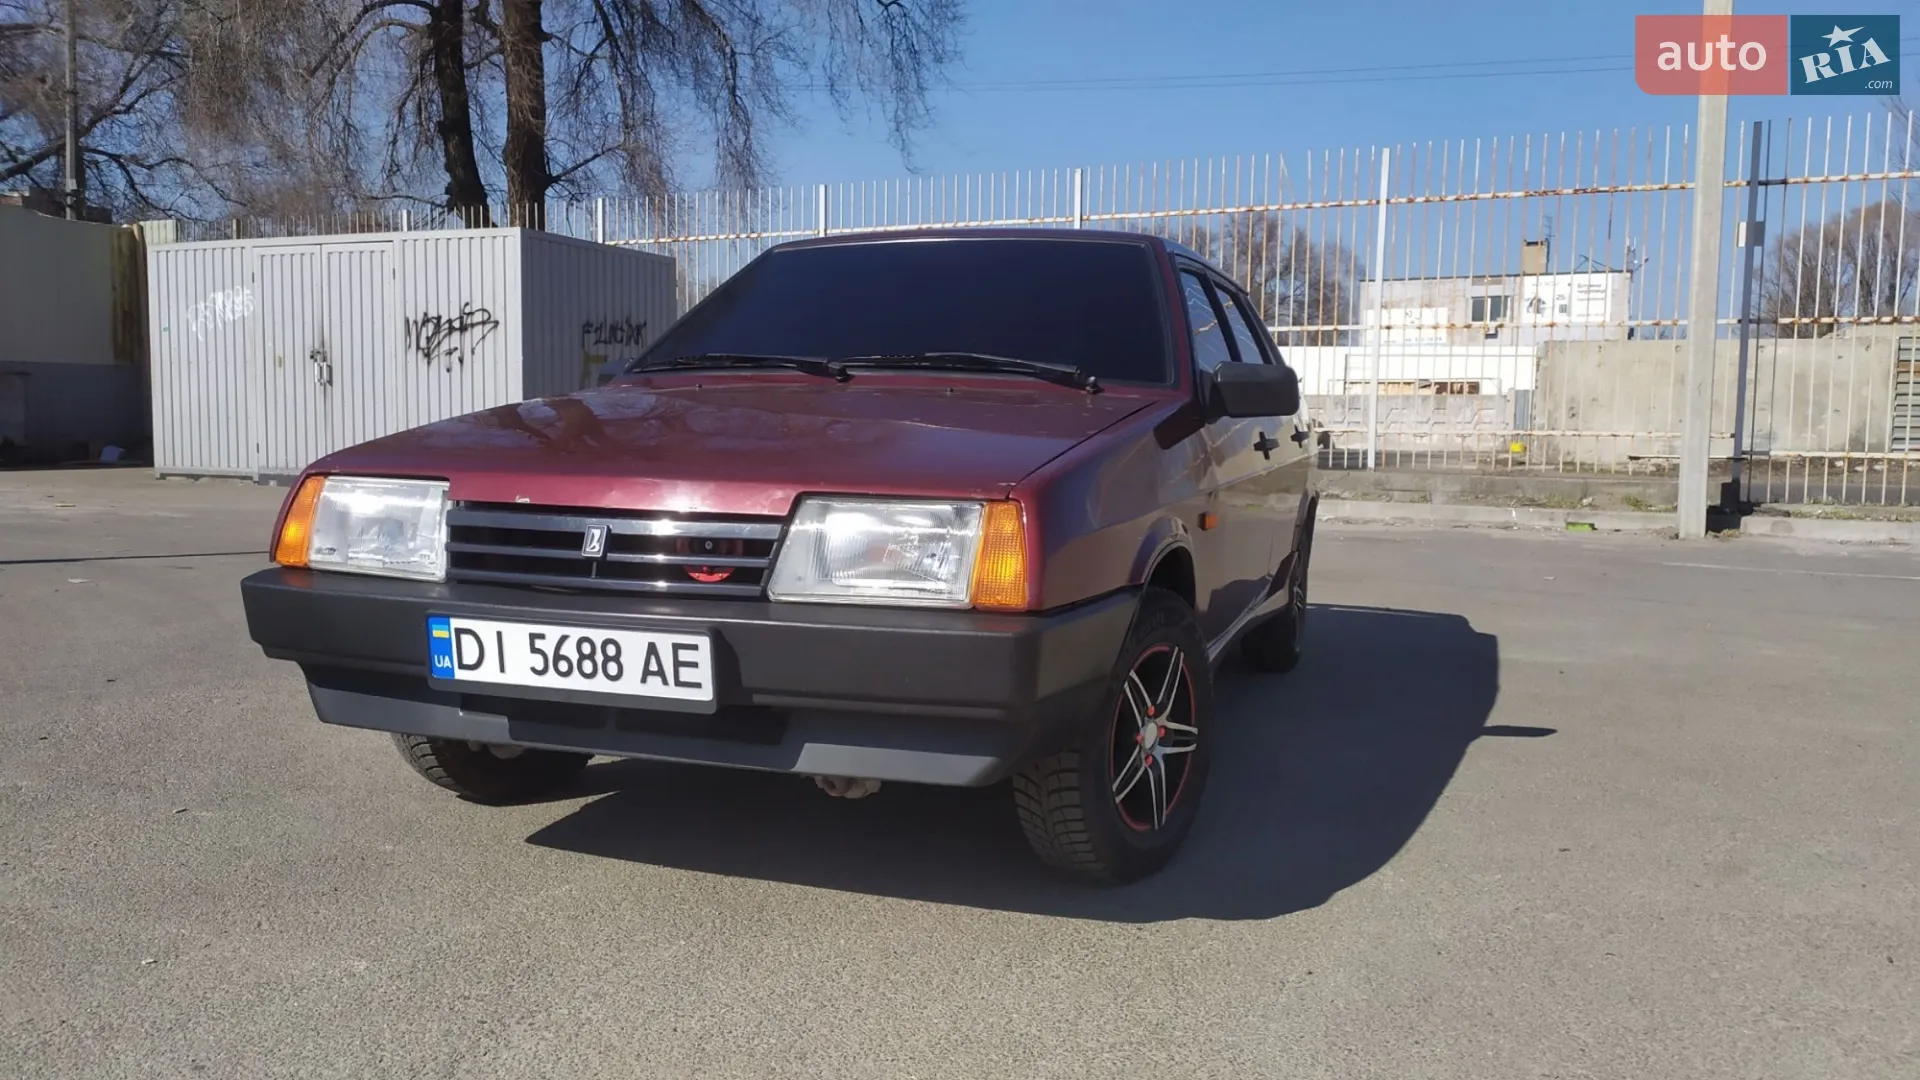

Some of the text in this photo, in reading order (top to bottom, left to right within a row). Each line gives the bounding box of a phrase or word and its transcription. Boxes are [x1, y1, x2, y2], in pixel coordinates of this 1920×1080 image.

[434, 654, 452, 668] UA
[454, 627, 703, 689] DI 5688 AE
